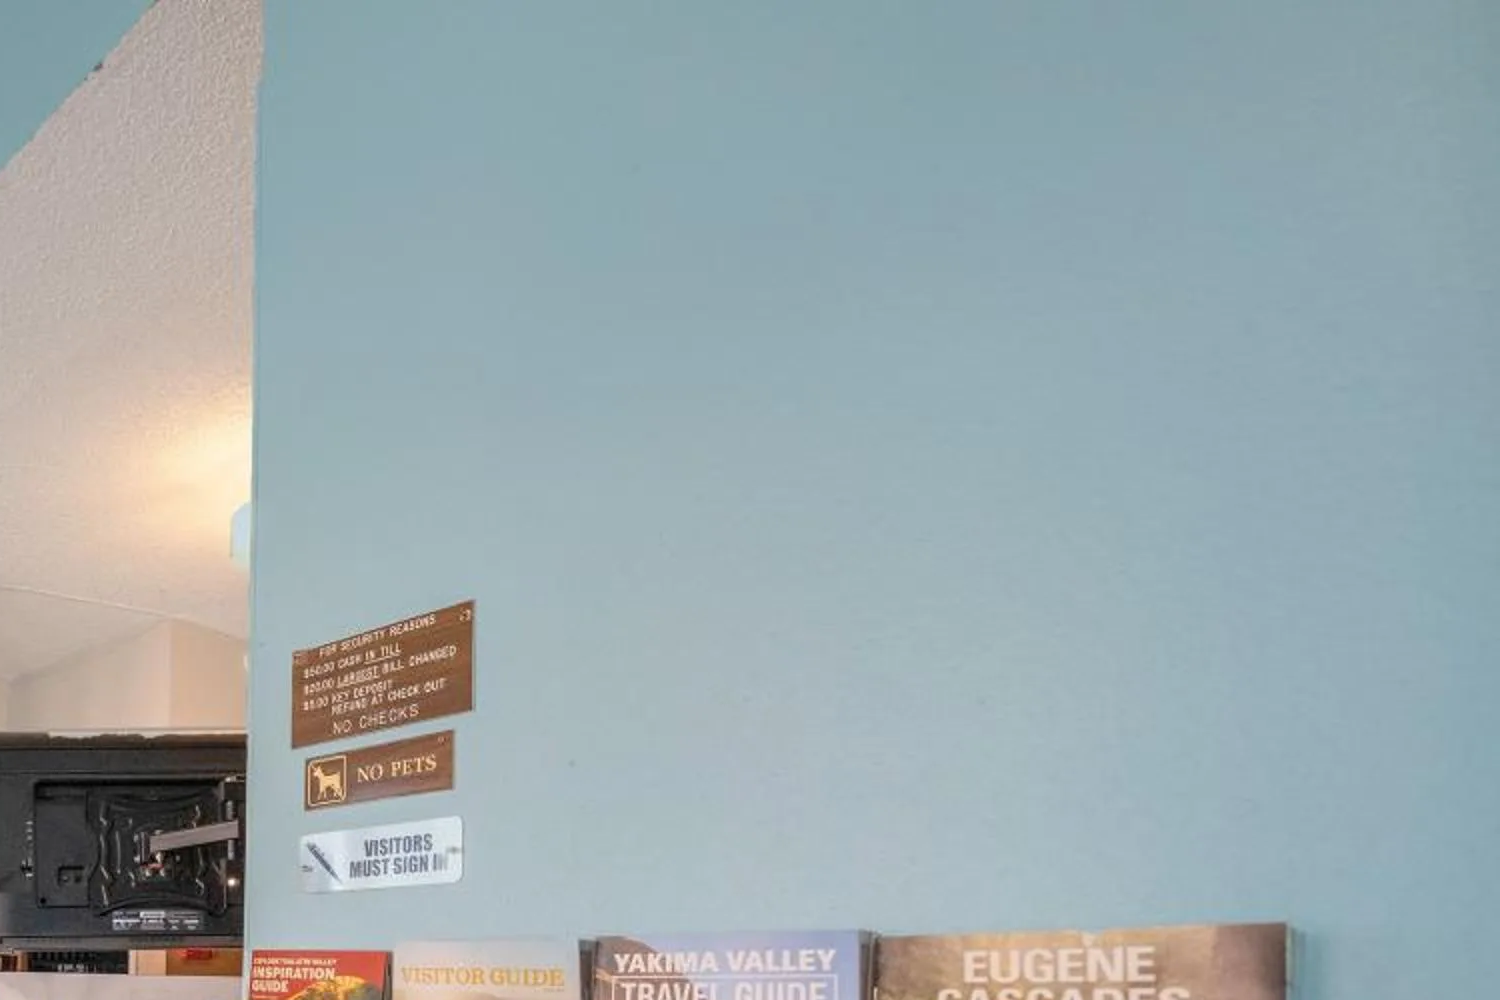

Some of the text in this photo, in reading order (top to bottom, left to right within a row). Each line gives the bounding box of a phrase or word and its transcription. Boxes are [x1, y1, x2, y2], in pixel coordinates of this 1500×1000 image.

[319, 613, 436, 658] FOR SECURITY REASONS
[337, 654, 362, 669] CASH
[364, 650, 376, 663] IN
[380, 643, 402, 657] TILL
[381, 660, 405, 674] BILL
[409, 645, 457, 667] CHANGED
[353, 680, 393, 698] DEPOSIT
[371, 695, 383, 706] AT
[388, 686, 419, 701] CHECK
[423, 678, 446, 693] OUT
[332, 704, 420, 735] NO CHECKS
[356, 754, 437, 783] NO PETS
[364, 833, 433, 857] VISITORS
[349, 853, 448, 879] MUST SIGN IN
[253, 967, 336, 981] INSPIRATION
[613, 949, 837, 973] YAKIMA VALLEY
[962, 945, 1156, 984] EUGENE
[251, 980, 289, 993] GUIDE
[401, 966, 565, 987] VISITOR GUIDE
